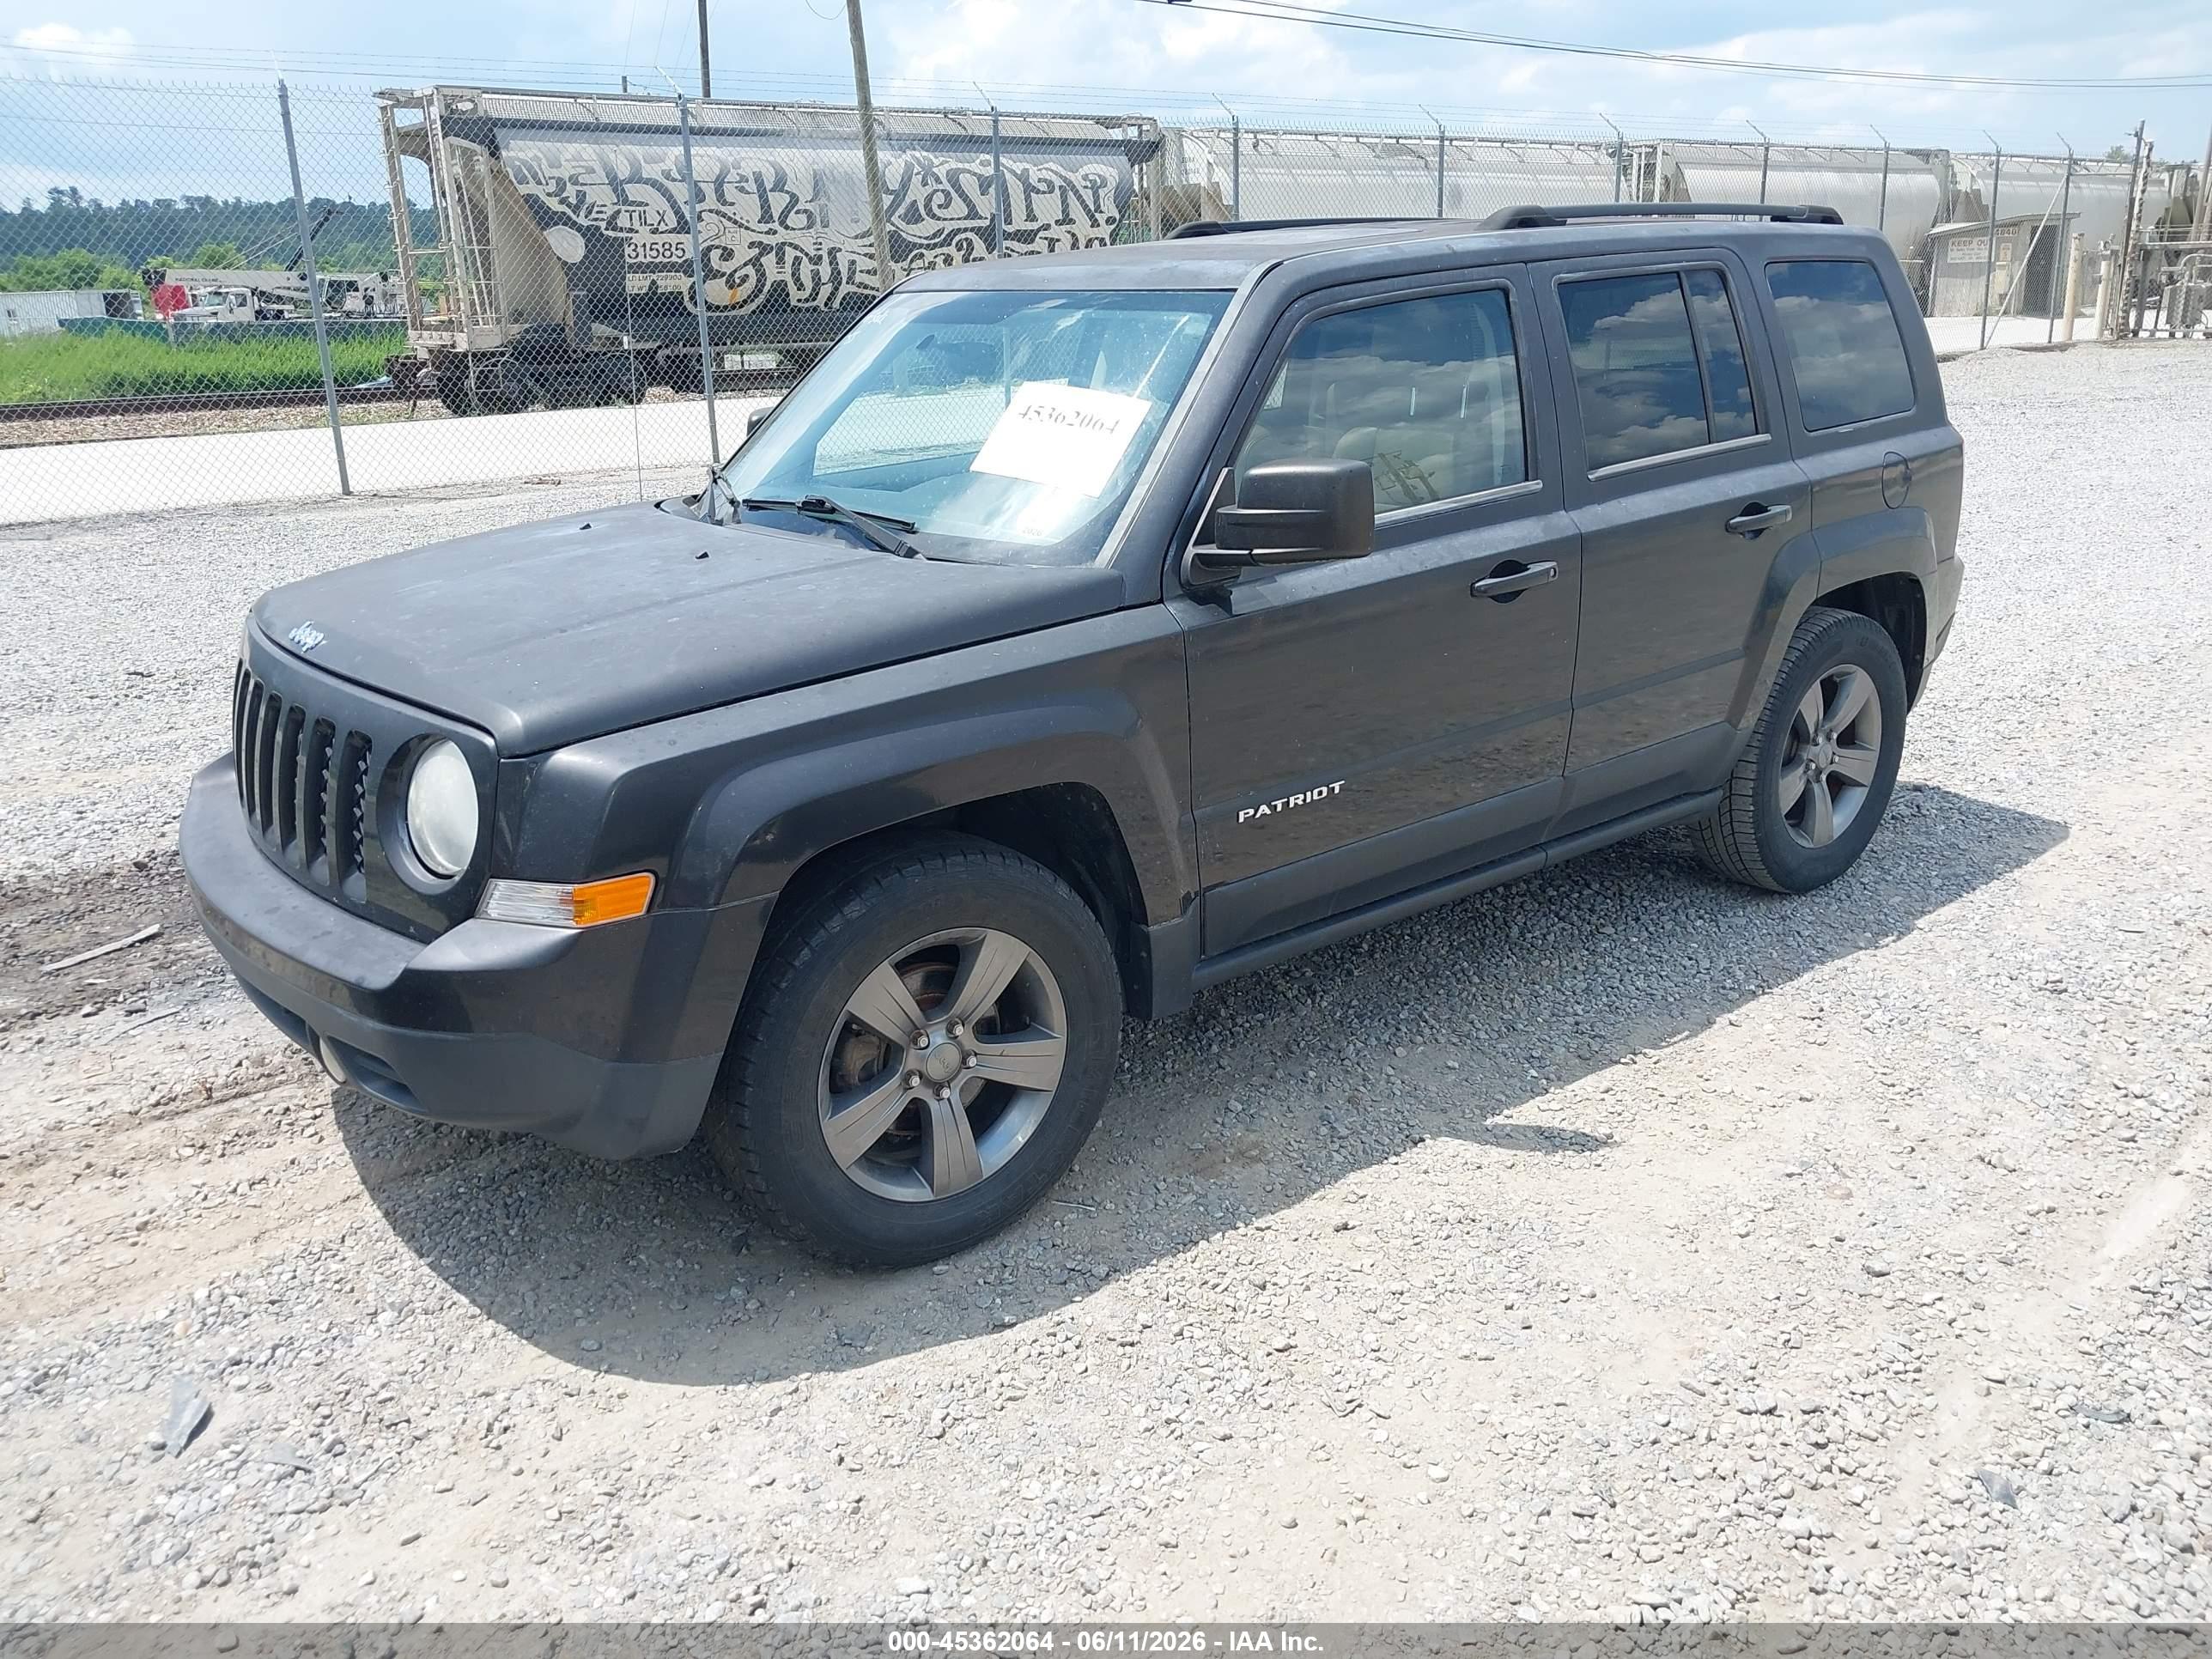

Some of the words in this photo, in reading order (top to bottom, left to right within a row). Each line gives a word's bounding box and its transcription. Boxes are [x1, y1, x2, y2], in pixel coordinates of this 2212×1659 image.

[624, 210, 668, 227] TILX
[627, 241, 686, 259] 31585
[1237, 780, 1346, 823] PATRIOT
